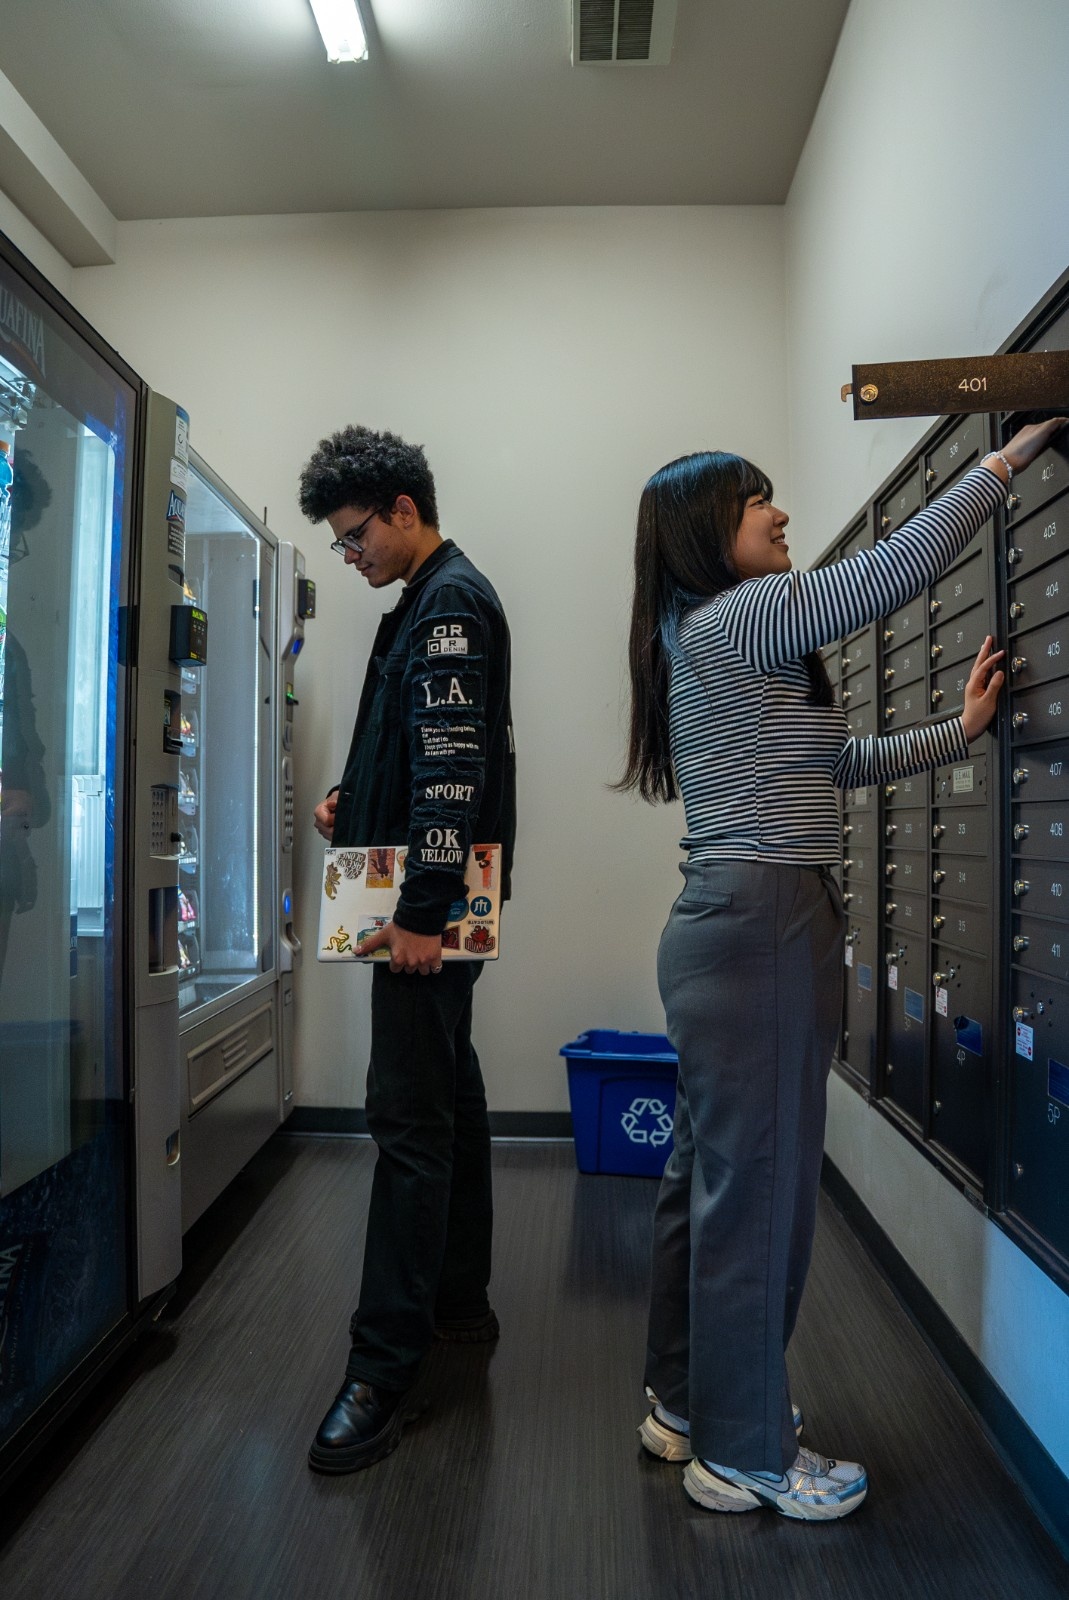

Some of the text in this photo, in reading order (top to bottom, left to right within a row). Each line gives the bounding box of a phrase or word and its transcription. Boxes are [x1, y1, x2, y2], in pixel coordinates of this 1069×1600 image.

[958, 377, 987, 392] 401
[1041, 463, 1055, 482] 402
[1043, 522, 1057, 540] 403
[954, 583, 963, 597] 310
[1045, 581, 1059, 599] 404
[433, 624, 463, 637] OR
[1047, 641, 1061, 658] 405
[422, 677, 473, 708] L.A.
[1048, 701, 1062, 716] 406
[1049, 761, 1063, 776] 407
[425, 783, 475, 802] SPORT
[1050, 822, 1064, 837] 408
[426, 828, 461, 849] OK
[421, 849, 464, 864] YELLOW
[1050, 882, 1063, 897] 410
[1051, 943, 1061, 958] 411
[956, 1048, 966, 1066] 4P
[1047, 1101, 1062, 1126] 5P
